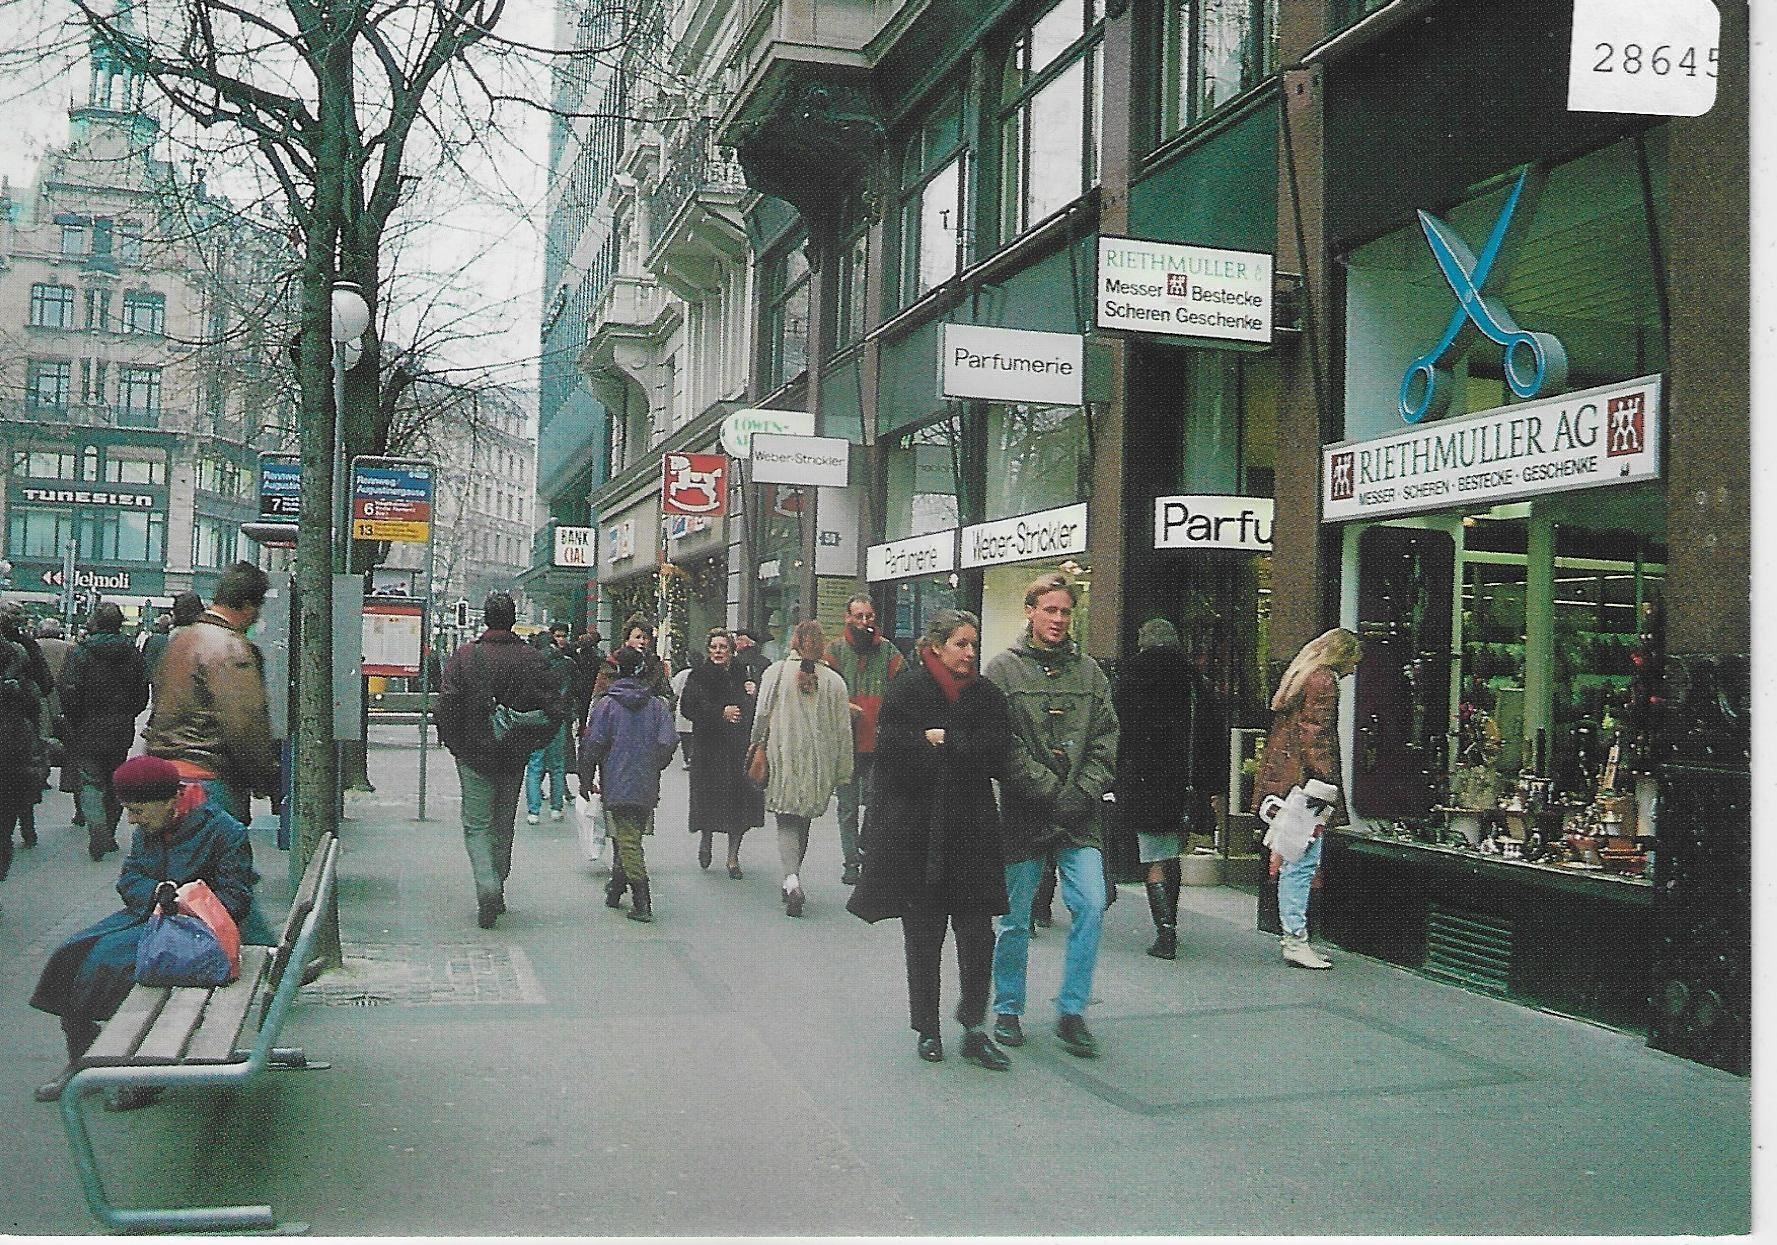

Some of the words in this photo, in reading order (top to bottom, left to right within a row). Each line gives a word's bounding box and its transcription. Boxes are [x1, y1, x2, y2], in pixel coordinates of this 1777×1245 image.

[1105, 278, 1164, 298] Messer
[1191, 285, 1263, 308] Bestecke
[1104, 300, 1171, 322] Scheren
[1175, 307, 1263, 331] Geschenke
[954, 347, 1073, 376] Parfumerie
[754, 450, 846, 467] Weber-Strickler
[1358, 415, 1544, 485] RIETHMULLER
[1551, 403, 1600, 452] AG
[1358, 487, 1396, 506] MESSER
[1402, 479, 1450, 500] SCHEREN
[1457, 469, 1513, 493] BESTECKE
[1522, 455, 1599, 484] GESCHENKE
[271, 498, 282, 512] 7
[363, 502, 375, 516] 6
[358, 524, 374, 537] 13
[560, 528, 589, 546] BANK
[1163, 502, 1274, 545] Parfu
[563, 546, 586, 564] CIAL
[971, 521, 1078, 562] Weber-Strickler
[884, 544, 939, 575] Parfumerie
